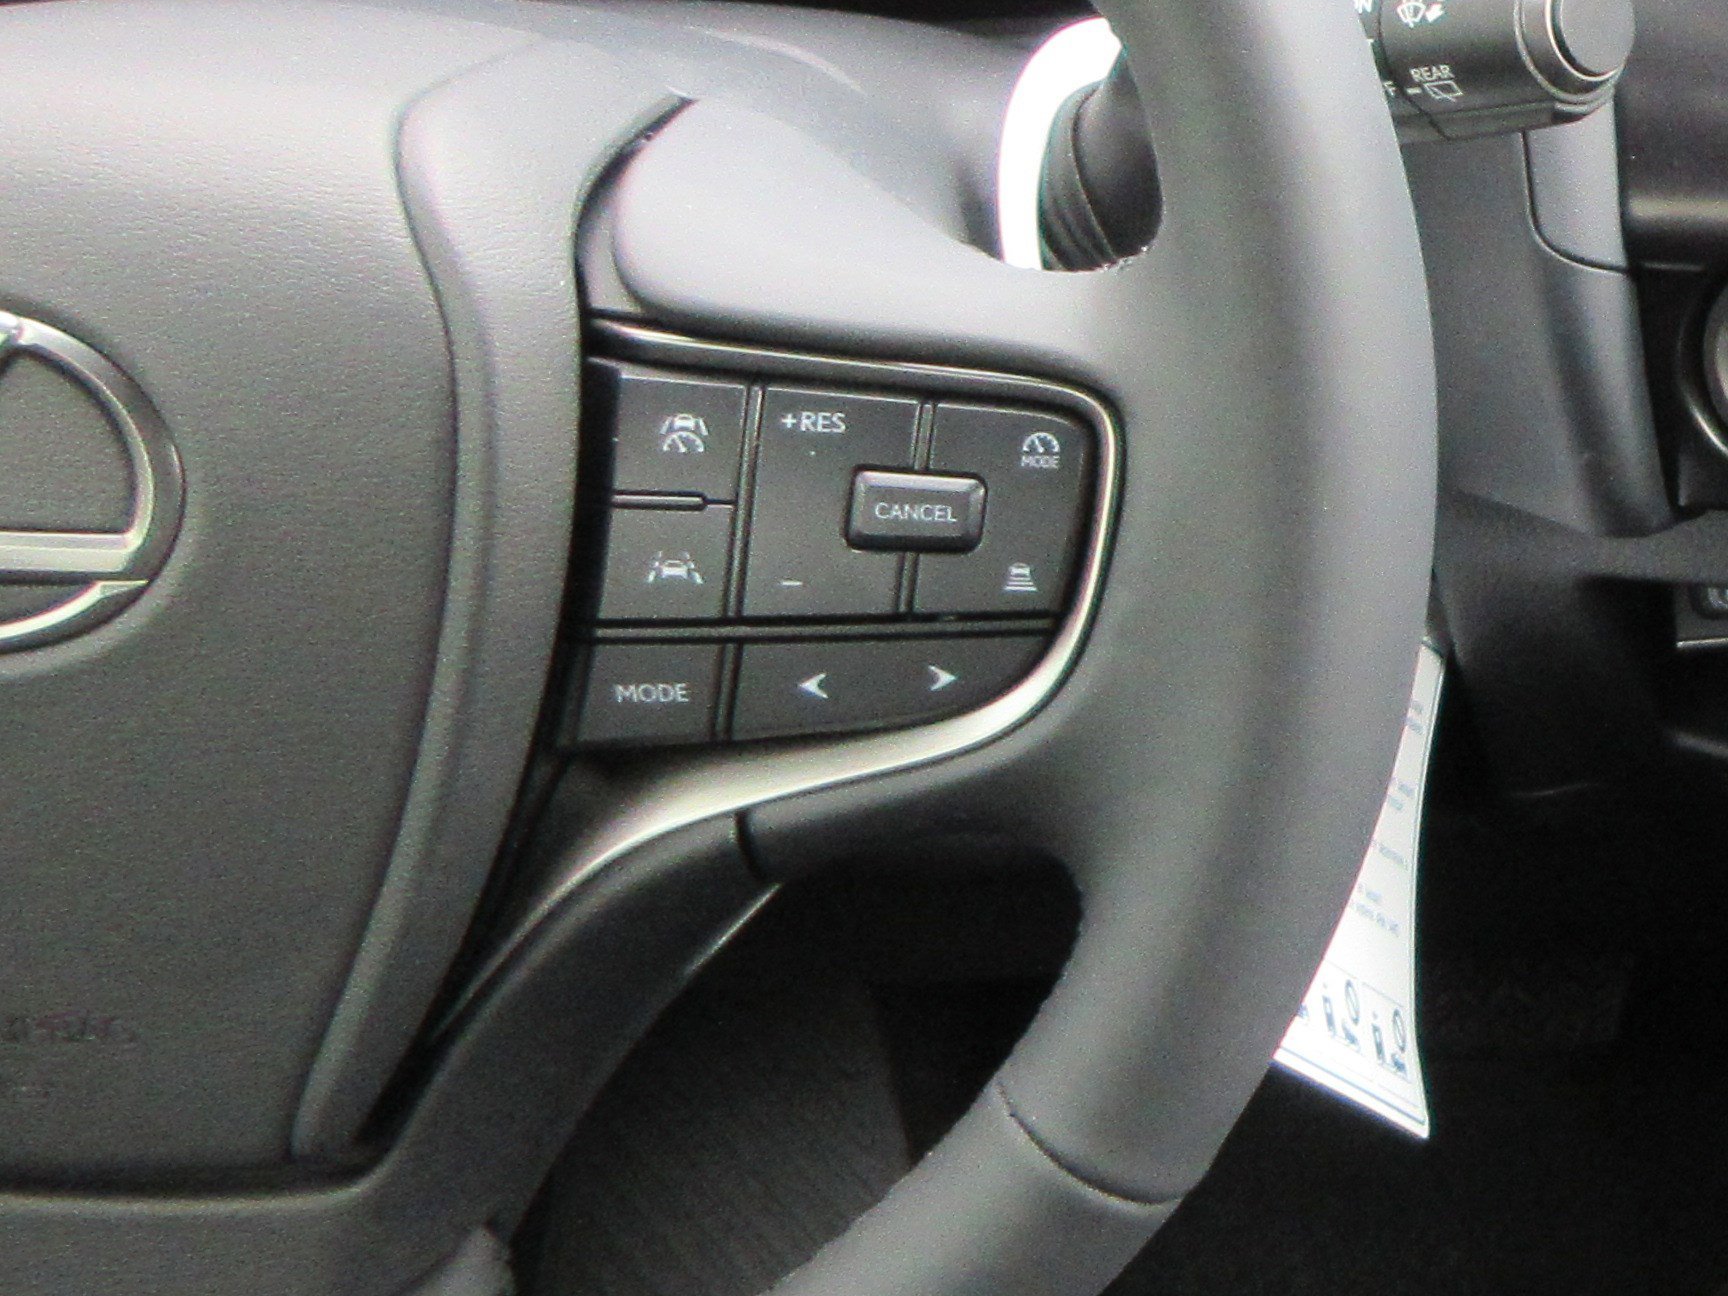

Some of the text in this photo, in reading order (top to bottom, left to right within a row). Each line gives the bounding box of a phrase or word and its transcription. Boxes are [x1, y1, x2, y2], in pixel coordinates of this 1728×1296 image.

[1410, 64, 1455, 82] REAR
[781, 411, 847, 434] +RES
[1020, 454, 1061, 470] MODE
[874, 501, 958, 524] CANCEL
[614, 683, 690, 703] MODE
